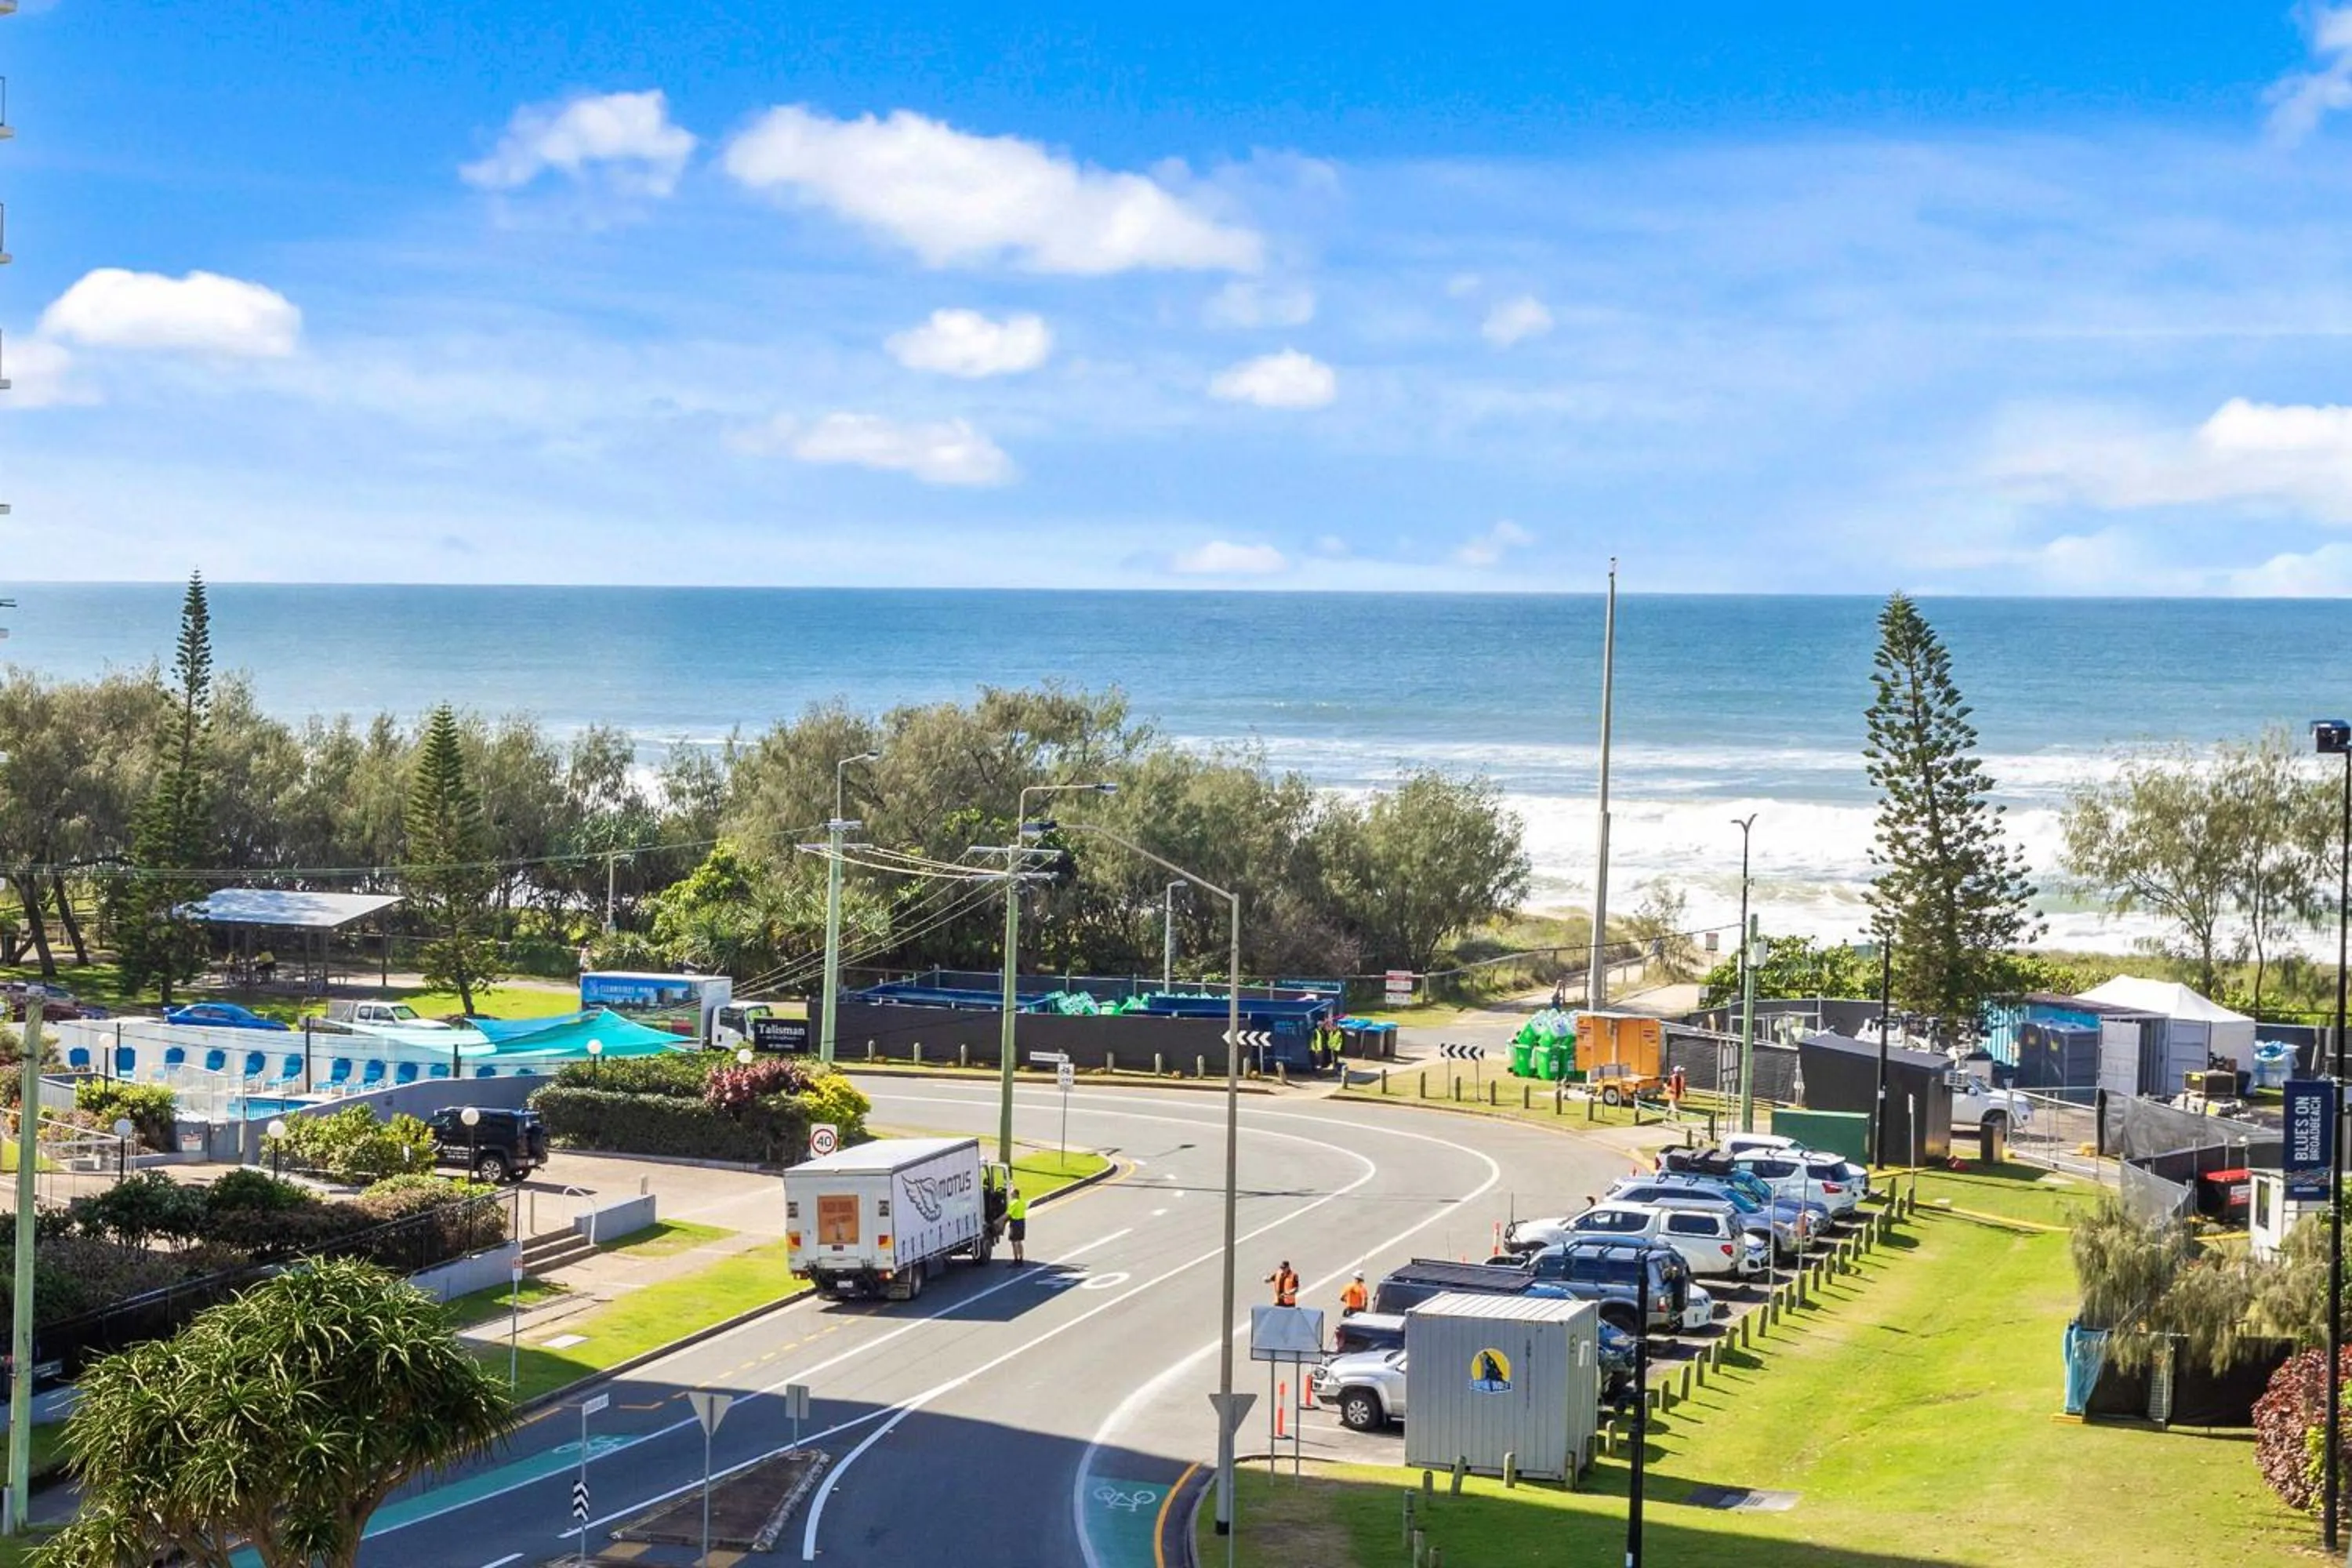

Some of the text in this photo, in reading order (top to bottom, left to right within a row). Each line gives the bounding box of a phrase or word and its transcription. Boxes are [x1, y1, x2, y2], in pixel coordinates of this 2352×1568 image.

[757, 1023, 805, 1035] Talisman
[816, 1135, 832, 1147] 40
[2294, 1096, 2310, 1161] BLUES ON
[2309, 1096, 2321, 1161] BROADBEACH
[938, 1170, 971, 1200] MOTUS
